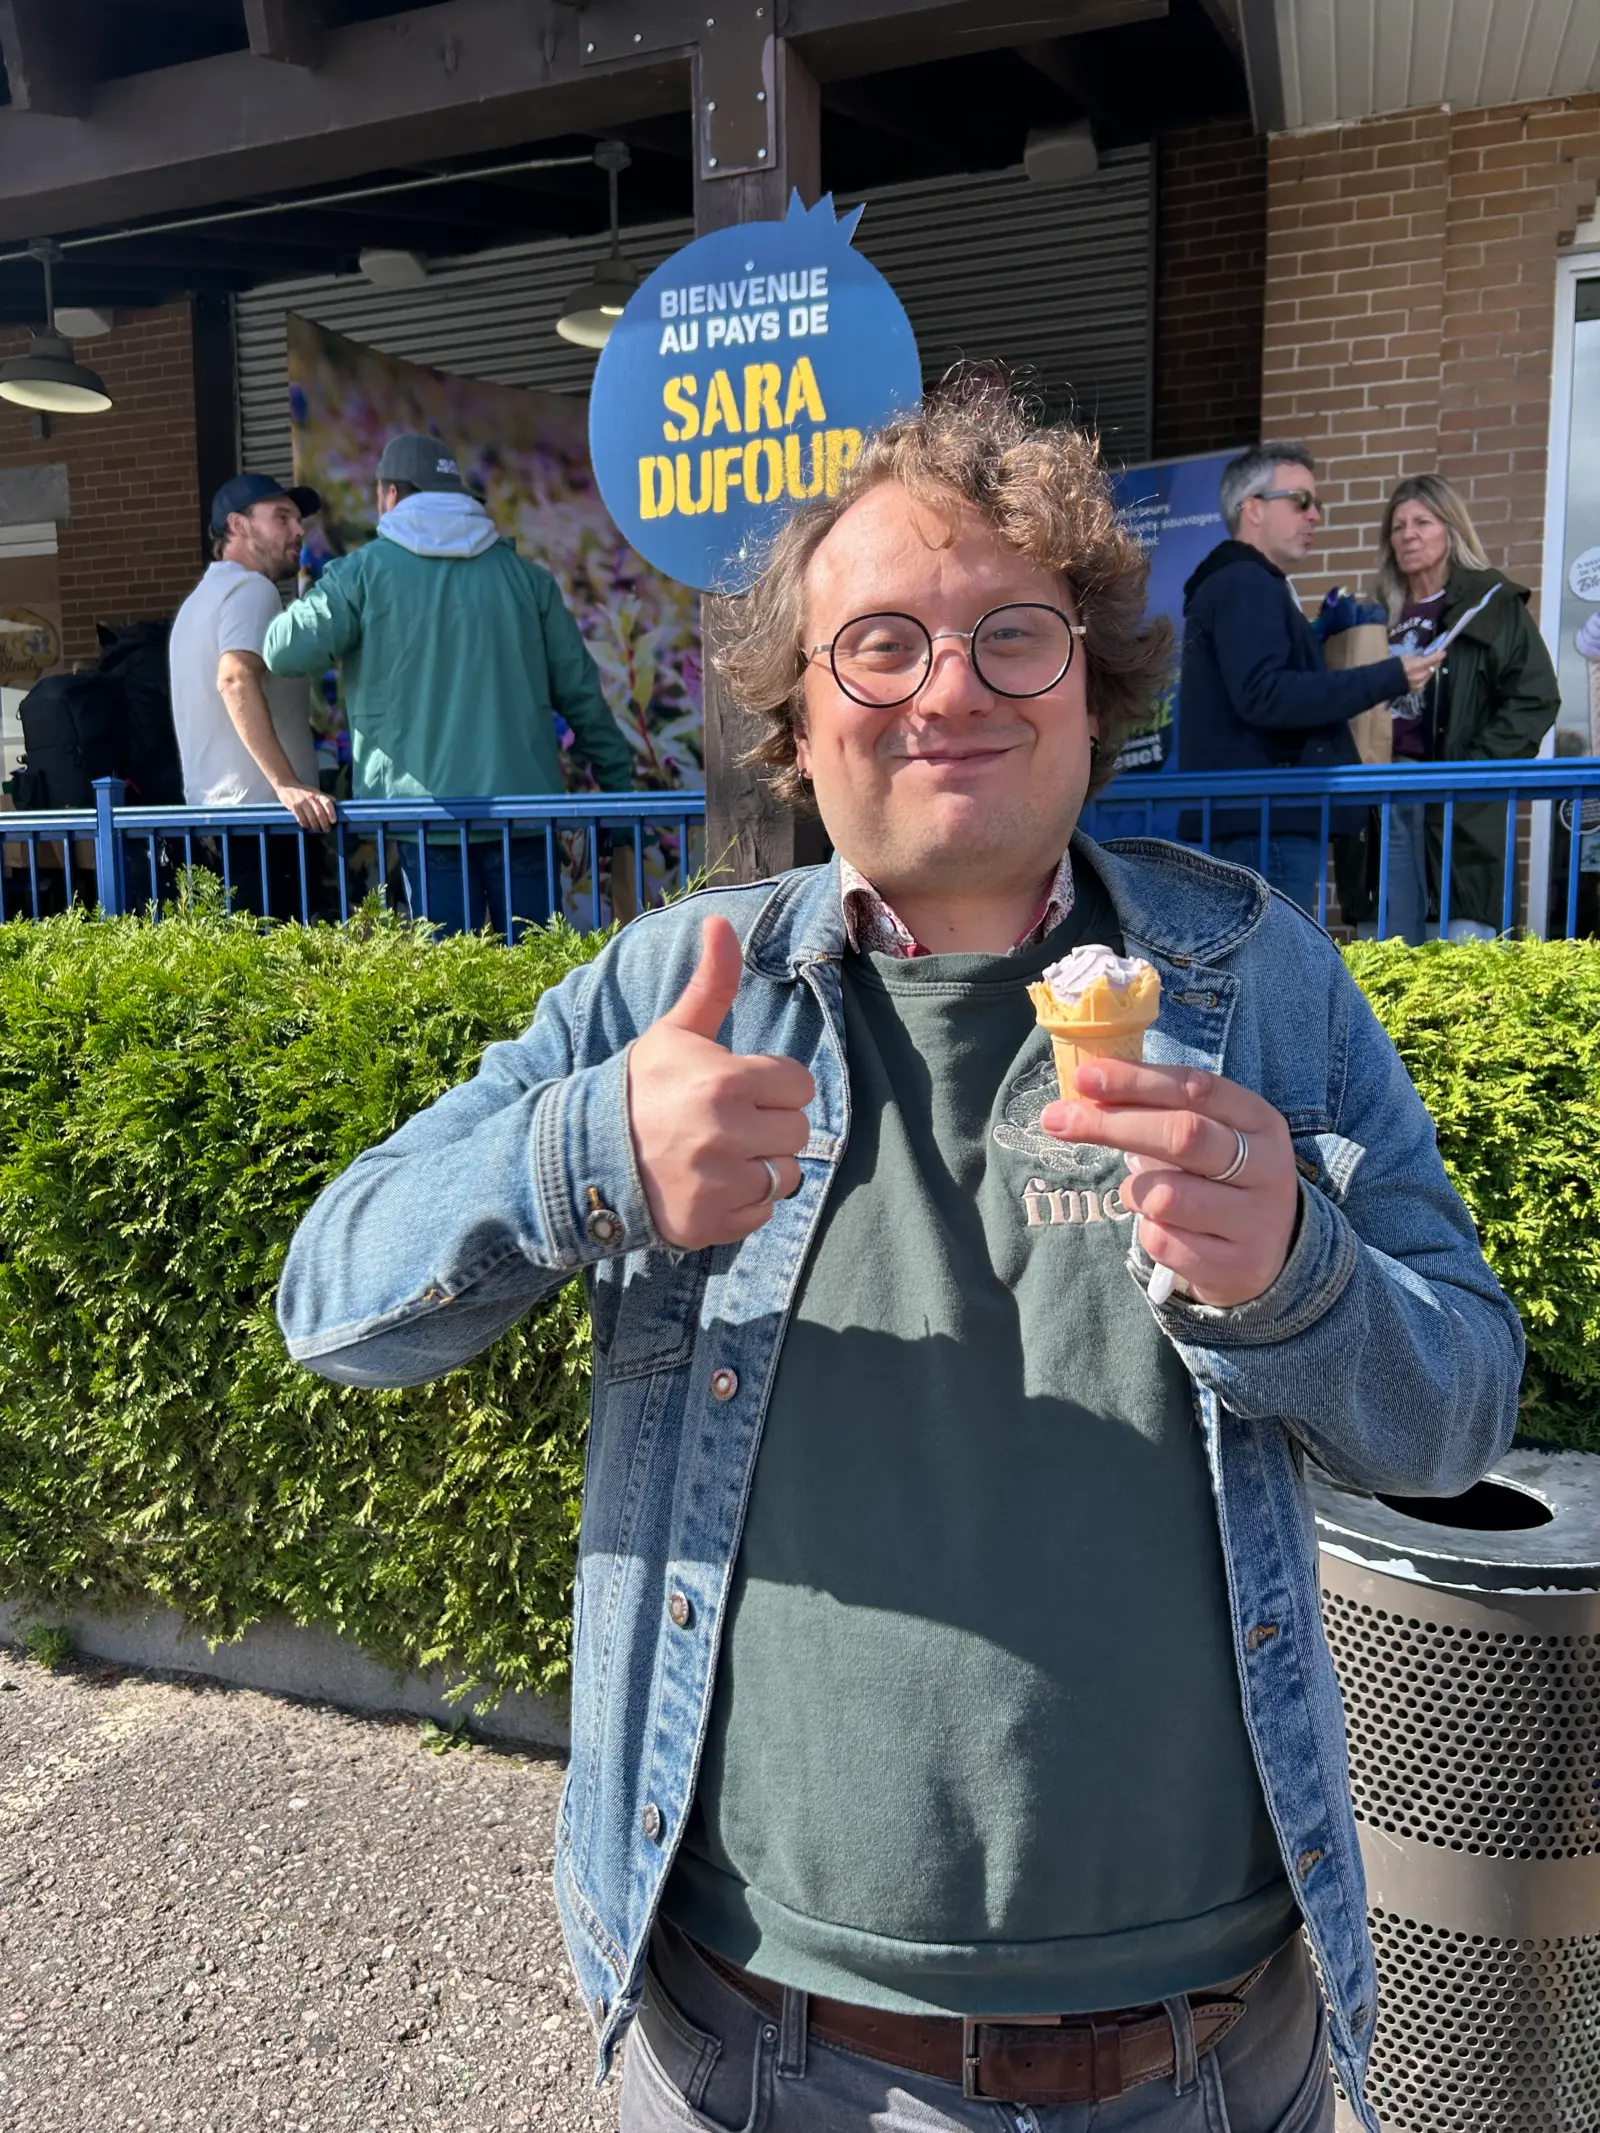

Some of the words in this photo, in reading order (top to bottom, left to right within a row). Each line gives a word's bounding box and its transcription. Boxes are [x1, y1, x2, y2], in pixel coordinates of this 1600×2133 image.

[659, 267, 829, 319] BIENVENUE
[659, 323, 699, 355] AU
[706, 313, 780, 347] PAYS
[788, 303, 829, 336] DE
[662, 356, 826, 442] SARA
